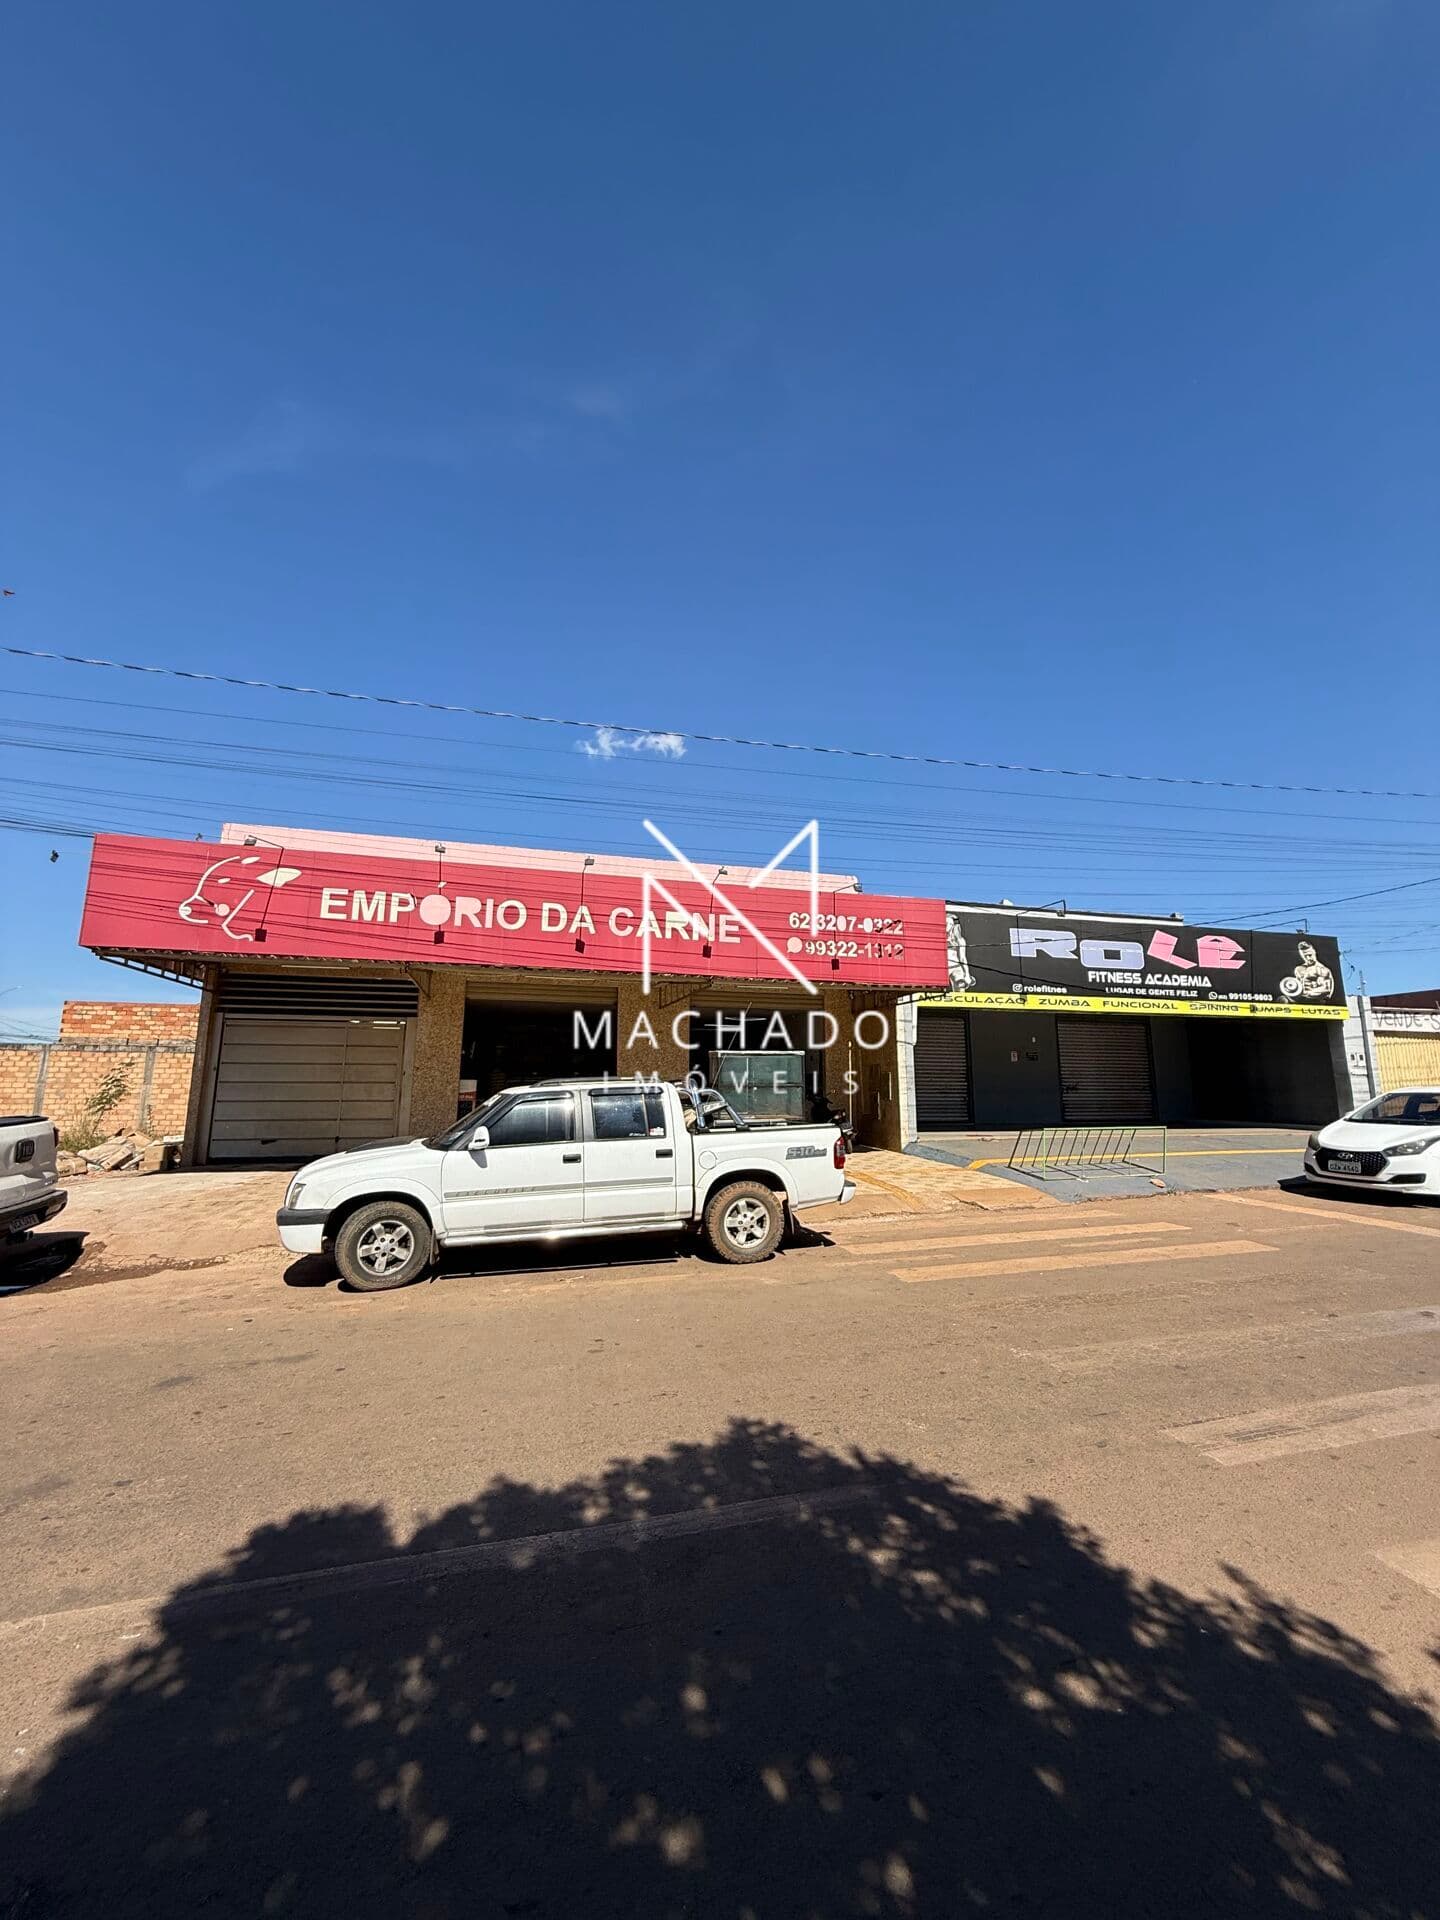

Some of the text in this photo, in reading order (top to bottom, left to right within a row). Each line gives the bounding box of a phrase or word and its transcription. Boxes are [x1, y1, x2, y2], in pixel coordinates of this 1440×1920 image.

[319, 881, 742, 944] EMPÓRIO DA CARNE
[789, 912, 811, 929] 62
[1088, 970, 1212, 988] FITNESS ACADEMIA
[1105, 987, 1135, 995] LUGAR
[1148, 989, 1176, 997] GENTE
[1176, 990, 1199, 998] FELIZ
[1038, 998, 1091, 1007] ZUMBA
[1103, 1000, 1179, 1010] FUNCIONAL
[1189, 1002, 1239, 1012] SPINING
[1250, 1005, 1292, 1014] UMPS
[1301, 1007, 1341, 1016] LUTAS
